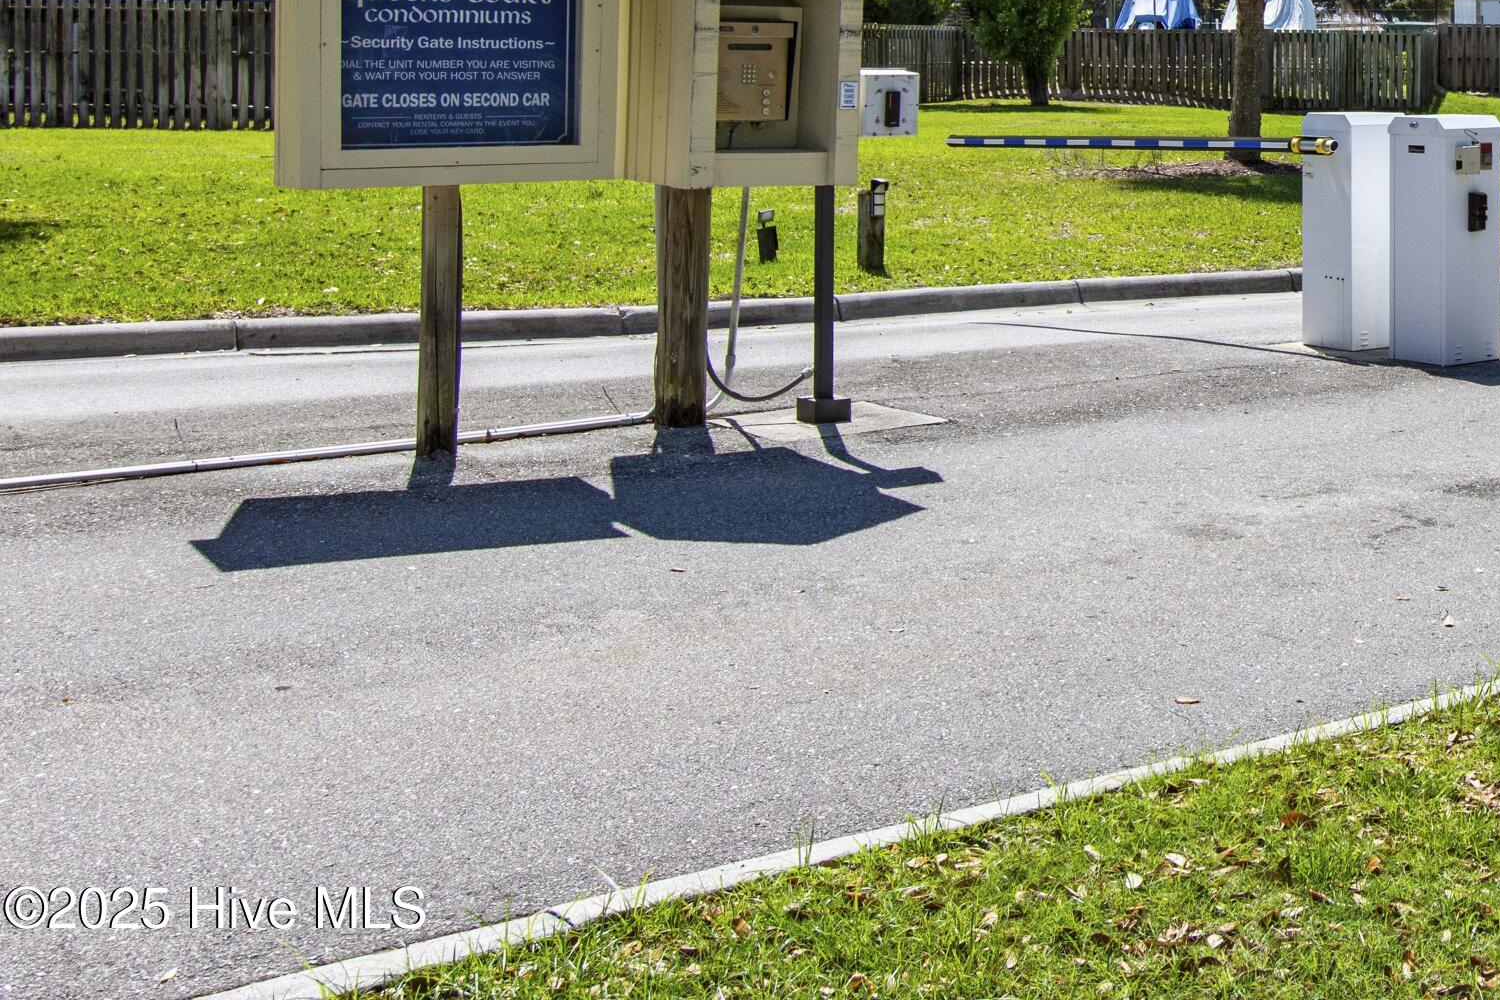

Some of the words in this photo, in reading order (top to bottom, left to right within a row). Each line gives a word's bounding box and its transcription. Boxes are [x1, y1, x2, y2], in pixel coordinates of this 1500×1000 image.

[418, 36, 454, 49] Gate
[364, 60, 386, 69] THE
[389, 60, 414, 69] UNIT
[417, 60, 464, 69] NUMBER
[467, 60, 488, 69] YOU
[490, 60, 510, 69] ARE
[513, 60, 556, 69] VISITING
[354, 72, 362, 81] &
[365, 72, 391, 81] WAIT
[394, 72, 416, 80] FOR
[419, 72, 447, 80] YOUR
[451, 72, 479, 80] HOST
[481, 72, 495, 80] TO
[497, 72, 541, 80] ANSWER
[343, 94, 379, 108] GATE
[382, 93, 437, 108] CLOSES
[441, 93, 460, 107] ON
[463, 93, 519, 107] SECOND
[523, 93, 550, 107] CAR
